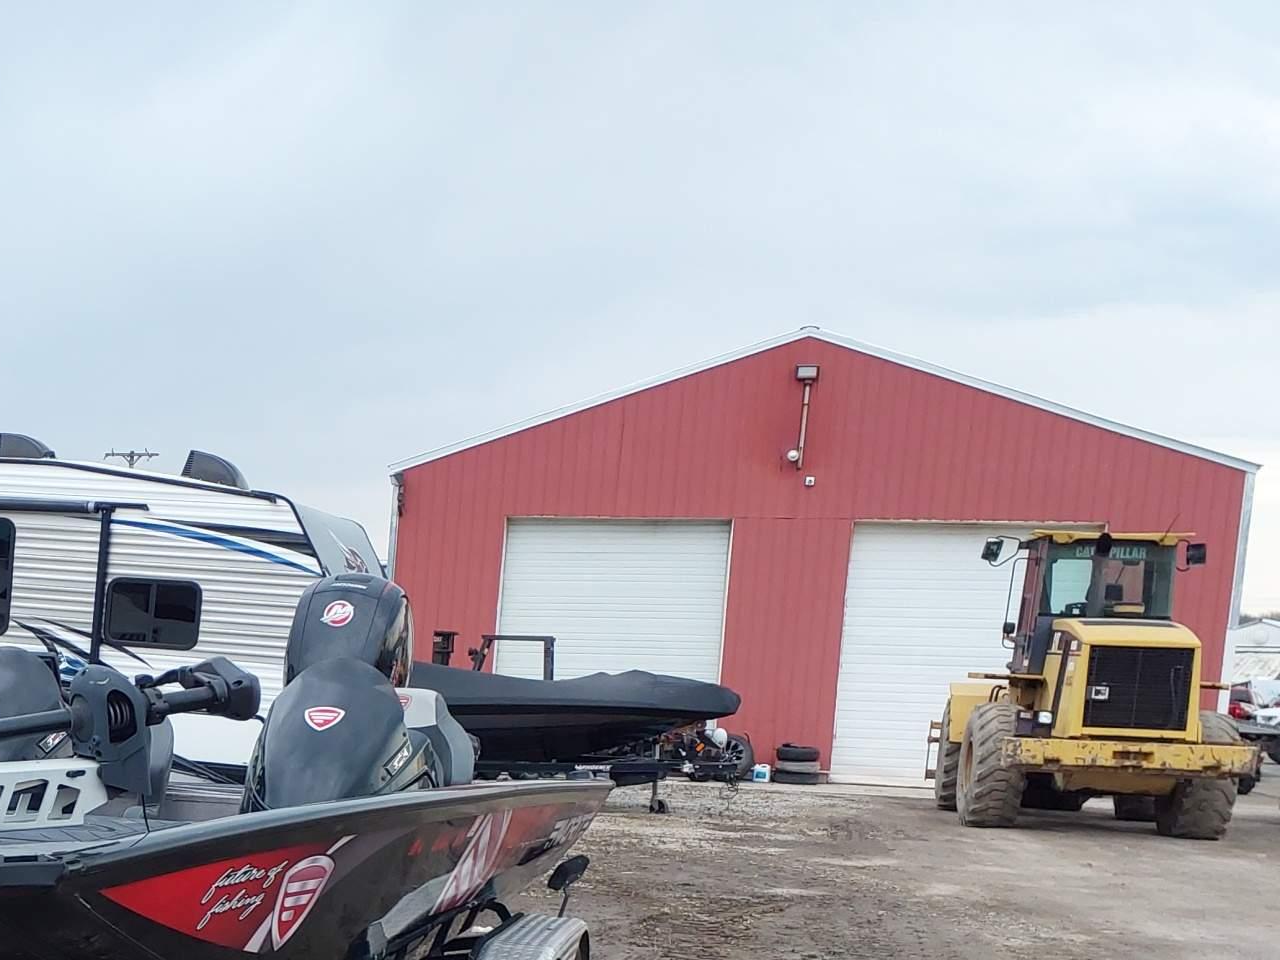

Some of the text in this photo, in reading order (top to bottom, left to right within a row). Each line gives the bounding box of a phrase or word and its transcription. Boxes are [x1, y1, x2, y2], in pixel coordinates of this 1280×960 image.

[1075, 546, 1147, 559] CATPILLAR
[201, 860, 289, 904] future of
[196, 889, 266, 931] fishing
